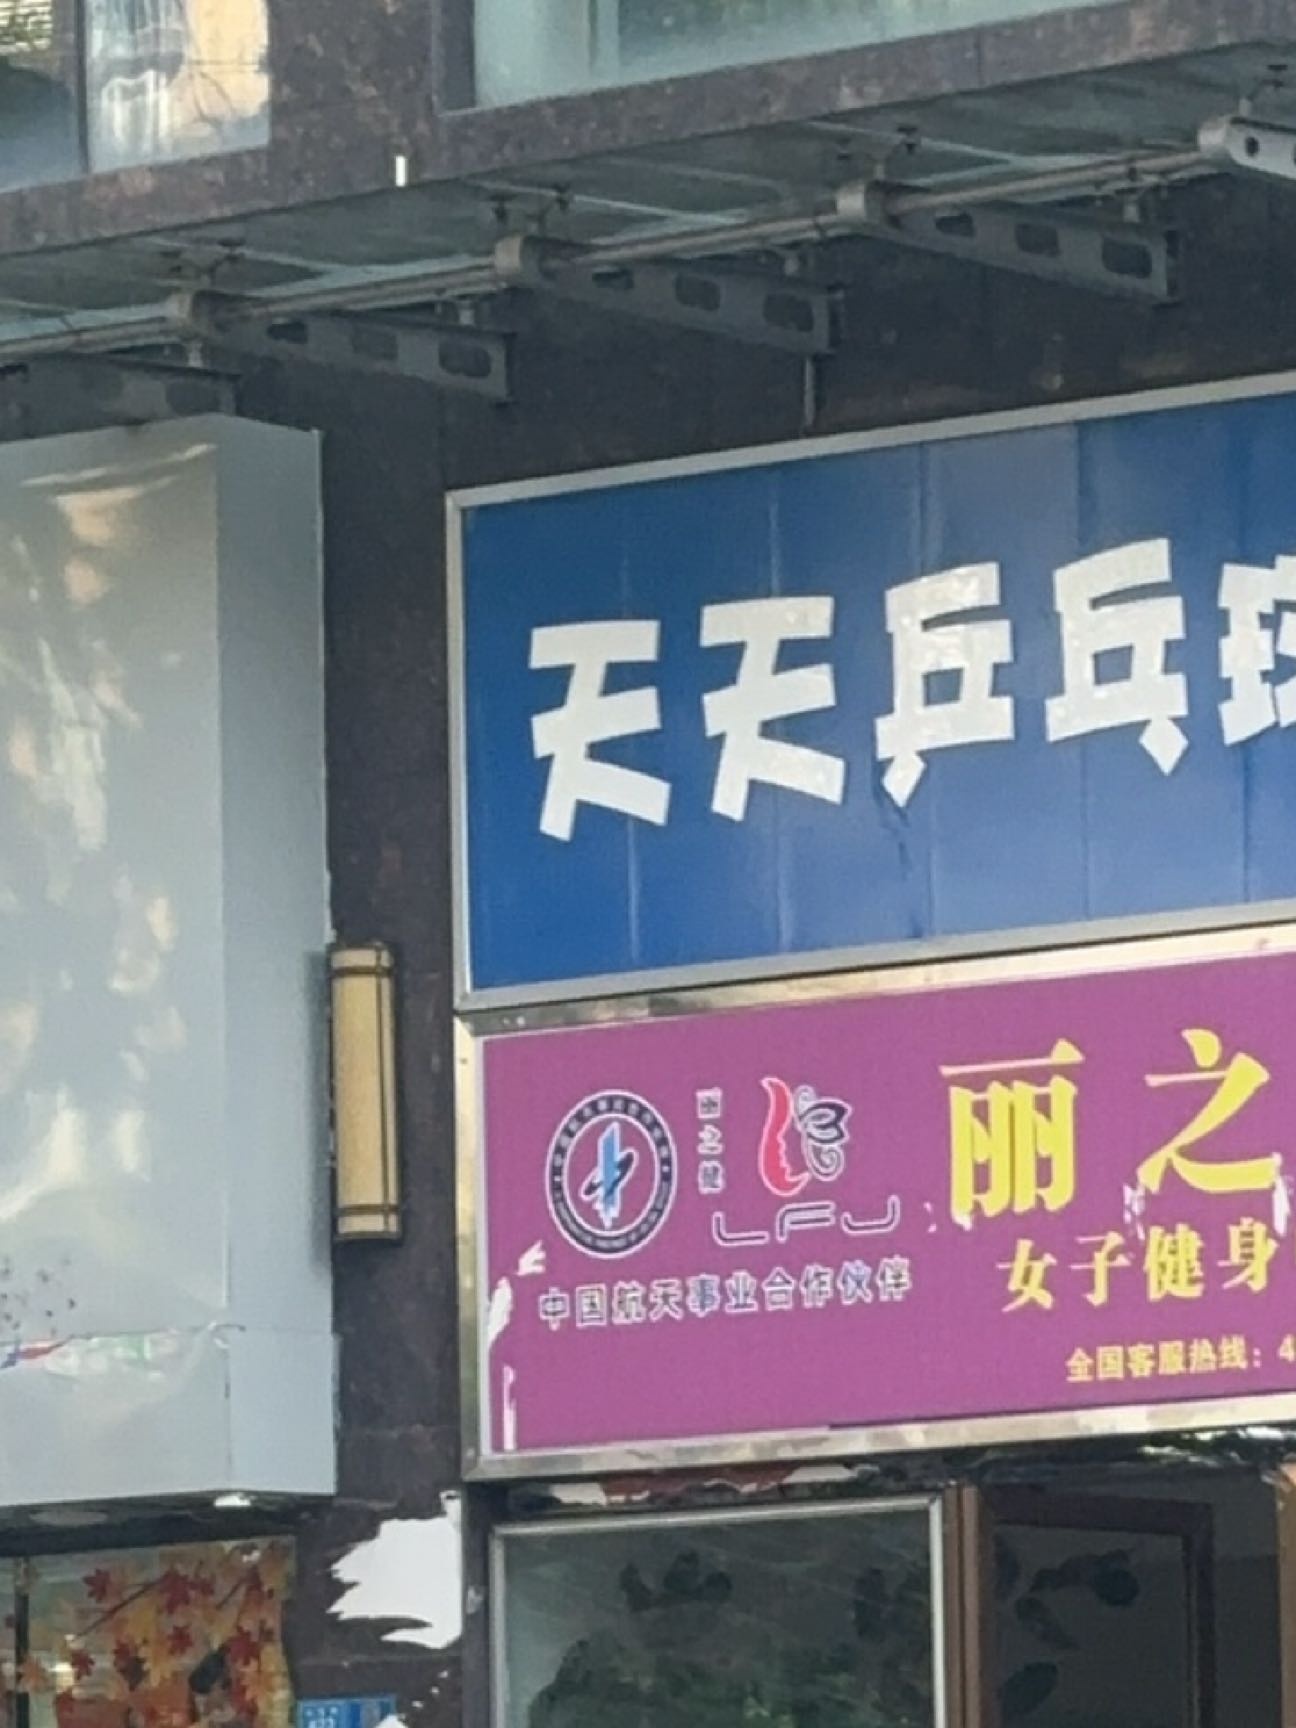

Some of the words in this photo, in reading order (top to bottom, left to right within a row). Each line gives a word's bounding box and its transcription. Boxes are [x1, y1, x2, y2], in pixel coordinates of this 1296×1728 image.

[538, 1255, 913, 1332] 中国航天事业合作伙伴
